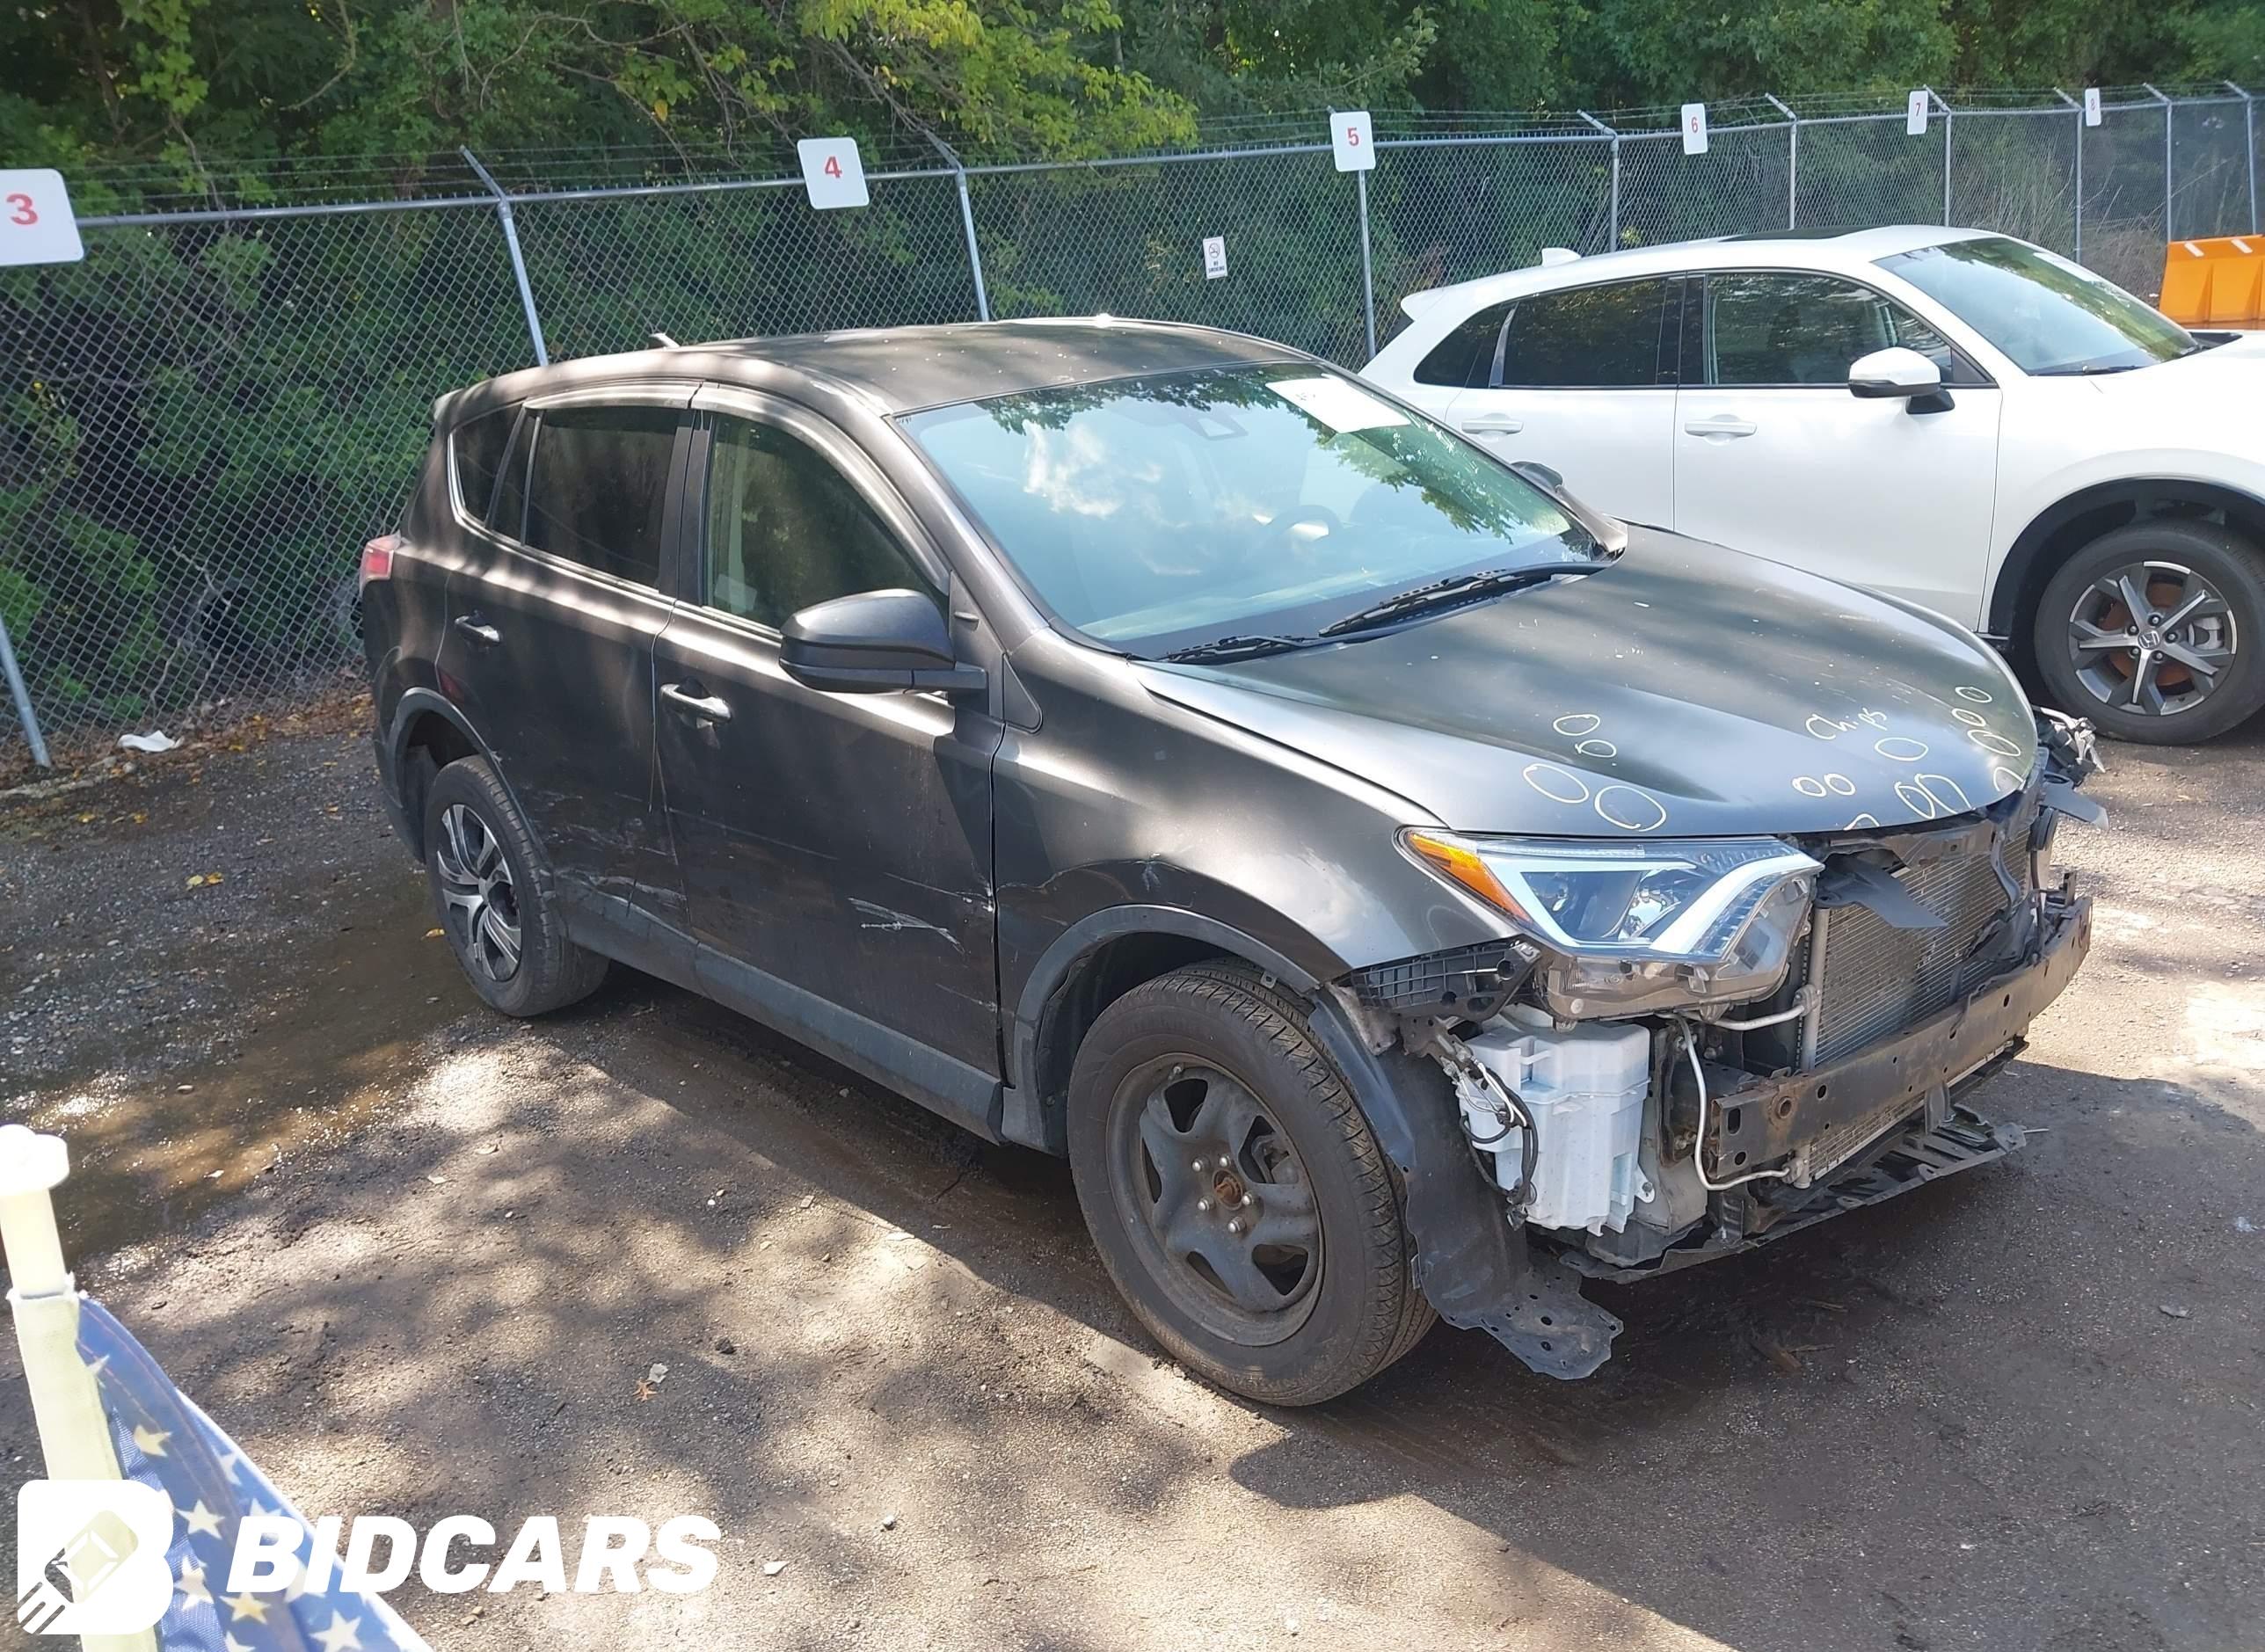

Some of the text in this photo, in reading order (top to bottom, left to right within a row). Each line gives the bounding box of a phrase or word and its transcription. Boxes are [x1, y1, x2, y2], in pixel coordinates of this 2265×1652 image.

[1915, 103, 1921, 117] 7
[1691, 117, 1699, 133] 6
[1347, 127, 1359, 147] 5
[824, 156, 843, 178] 4
[6, 193, 38, 225] 3
